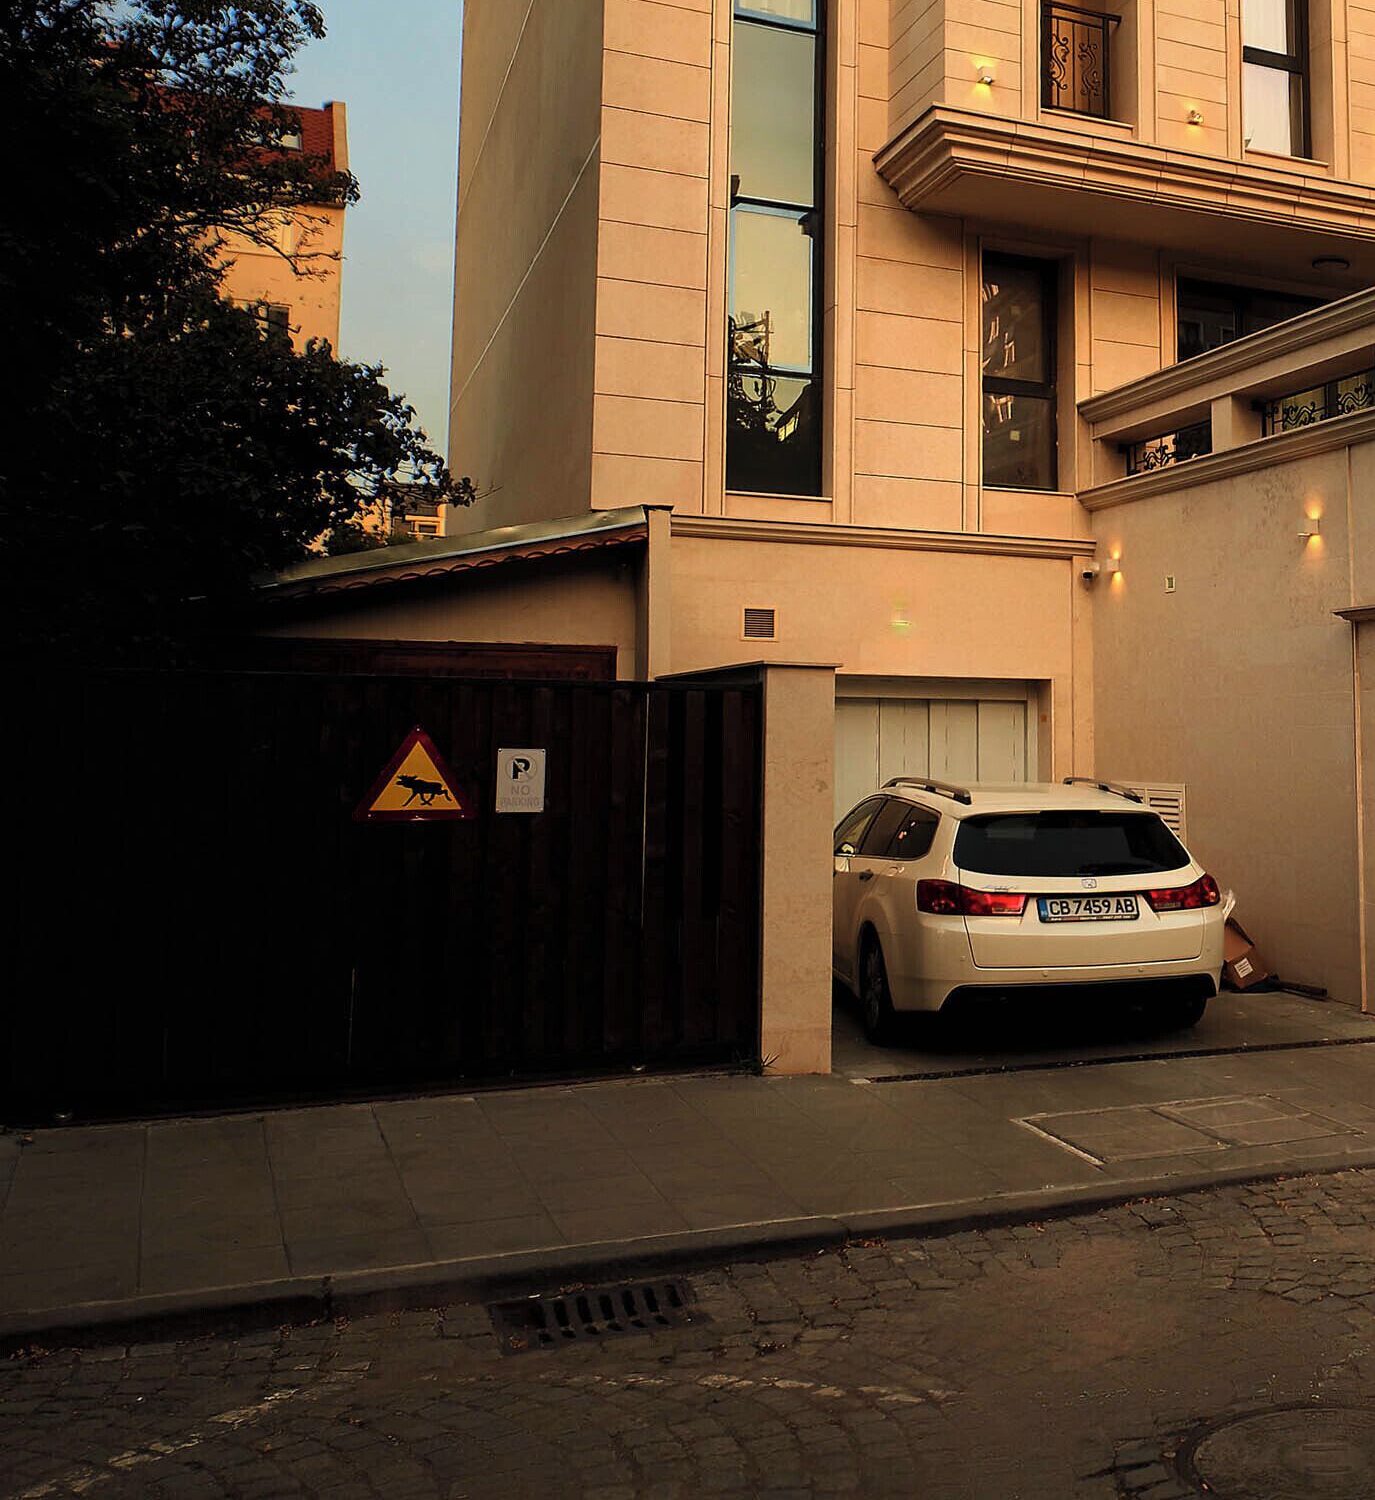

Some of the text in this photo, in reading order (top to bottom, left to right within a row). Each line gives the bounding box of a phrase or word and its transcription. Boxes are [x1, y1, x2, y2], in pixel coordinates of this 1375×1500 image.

[512, 756, 530, 779] P
[511, 785, 530, 796] NO
[500, 796, 540, 807] PARKING
[1049, 898, 1135, 916] CB 7459 AB
